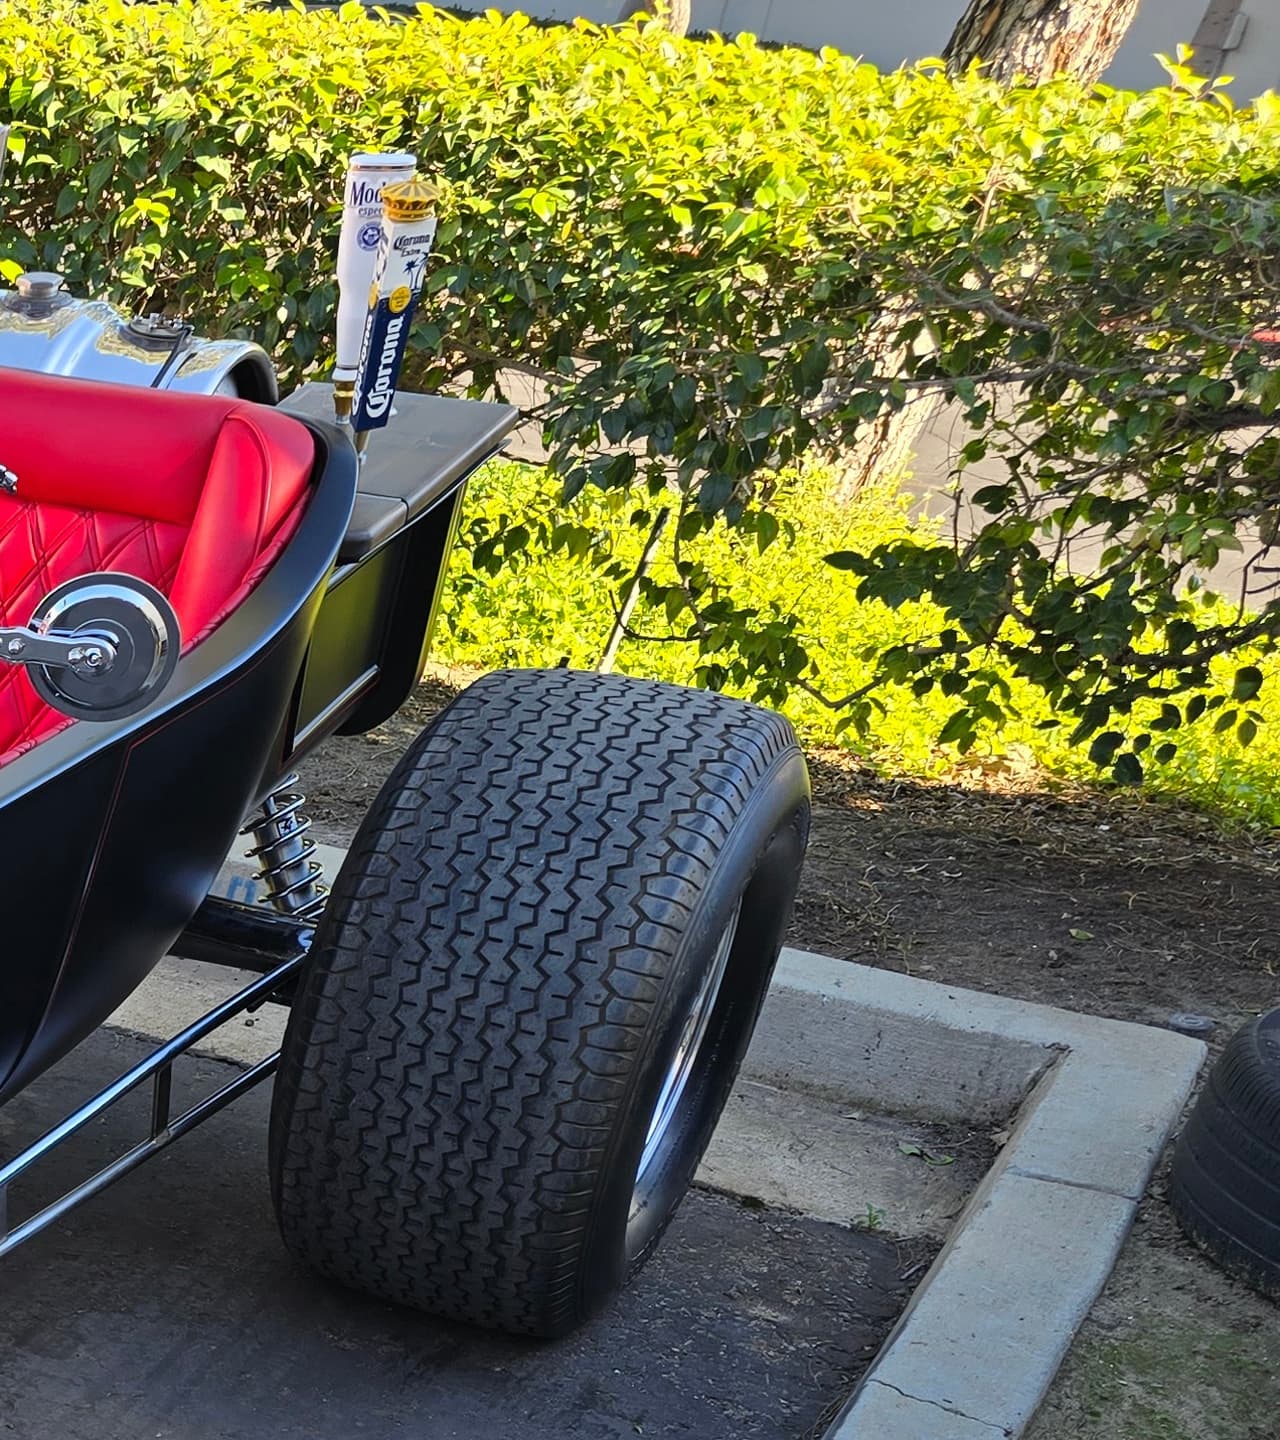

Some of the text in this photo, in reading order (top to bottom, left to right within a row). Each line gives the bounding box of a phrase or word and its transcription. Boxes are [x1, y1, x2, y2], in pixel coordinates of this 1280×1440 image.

[350, 181, 385, 206] Mod
[393, 234, 430, 250] Corona
[366, 316, 404, 418] Corona
